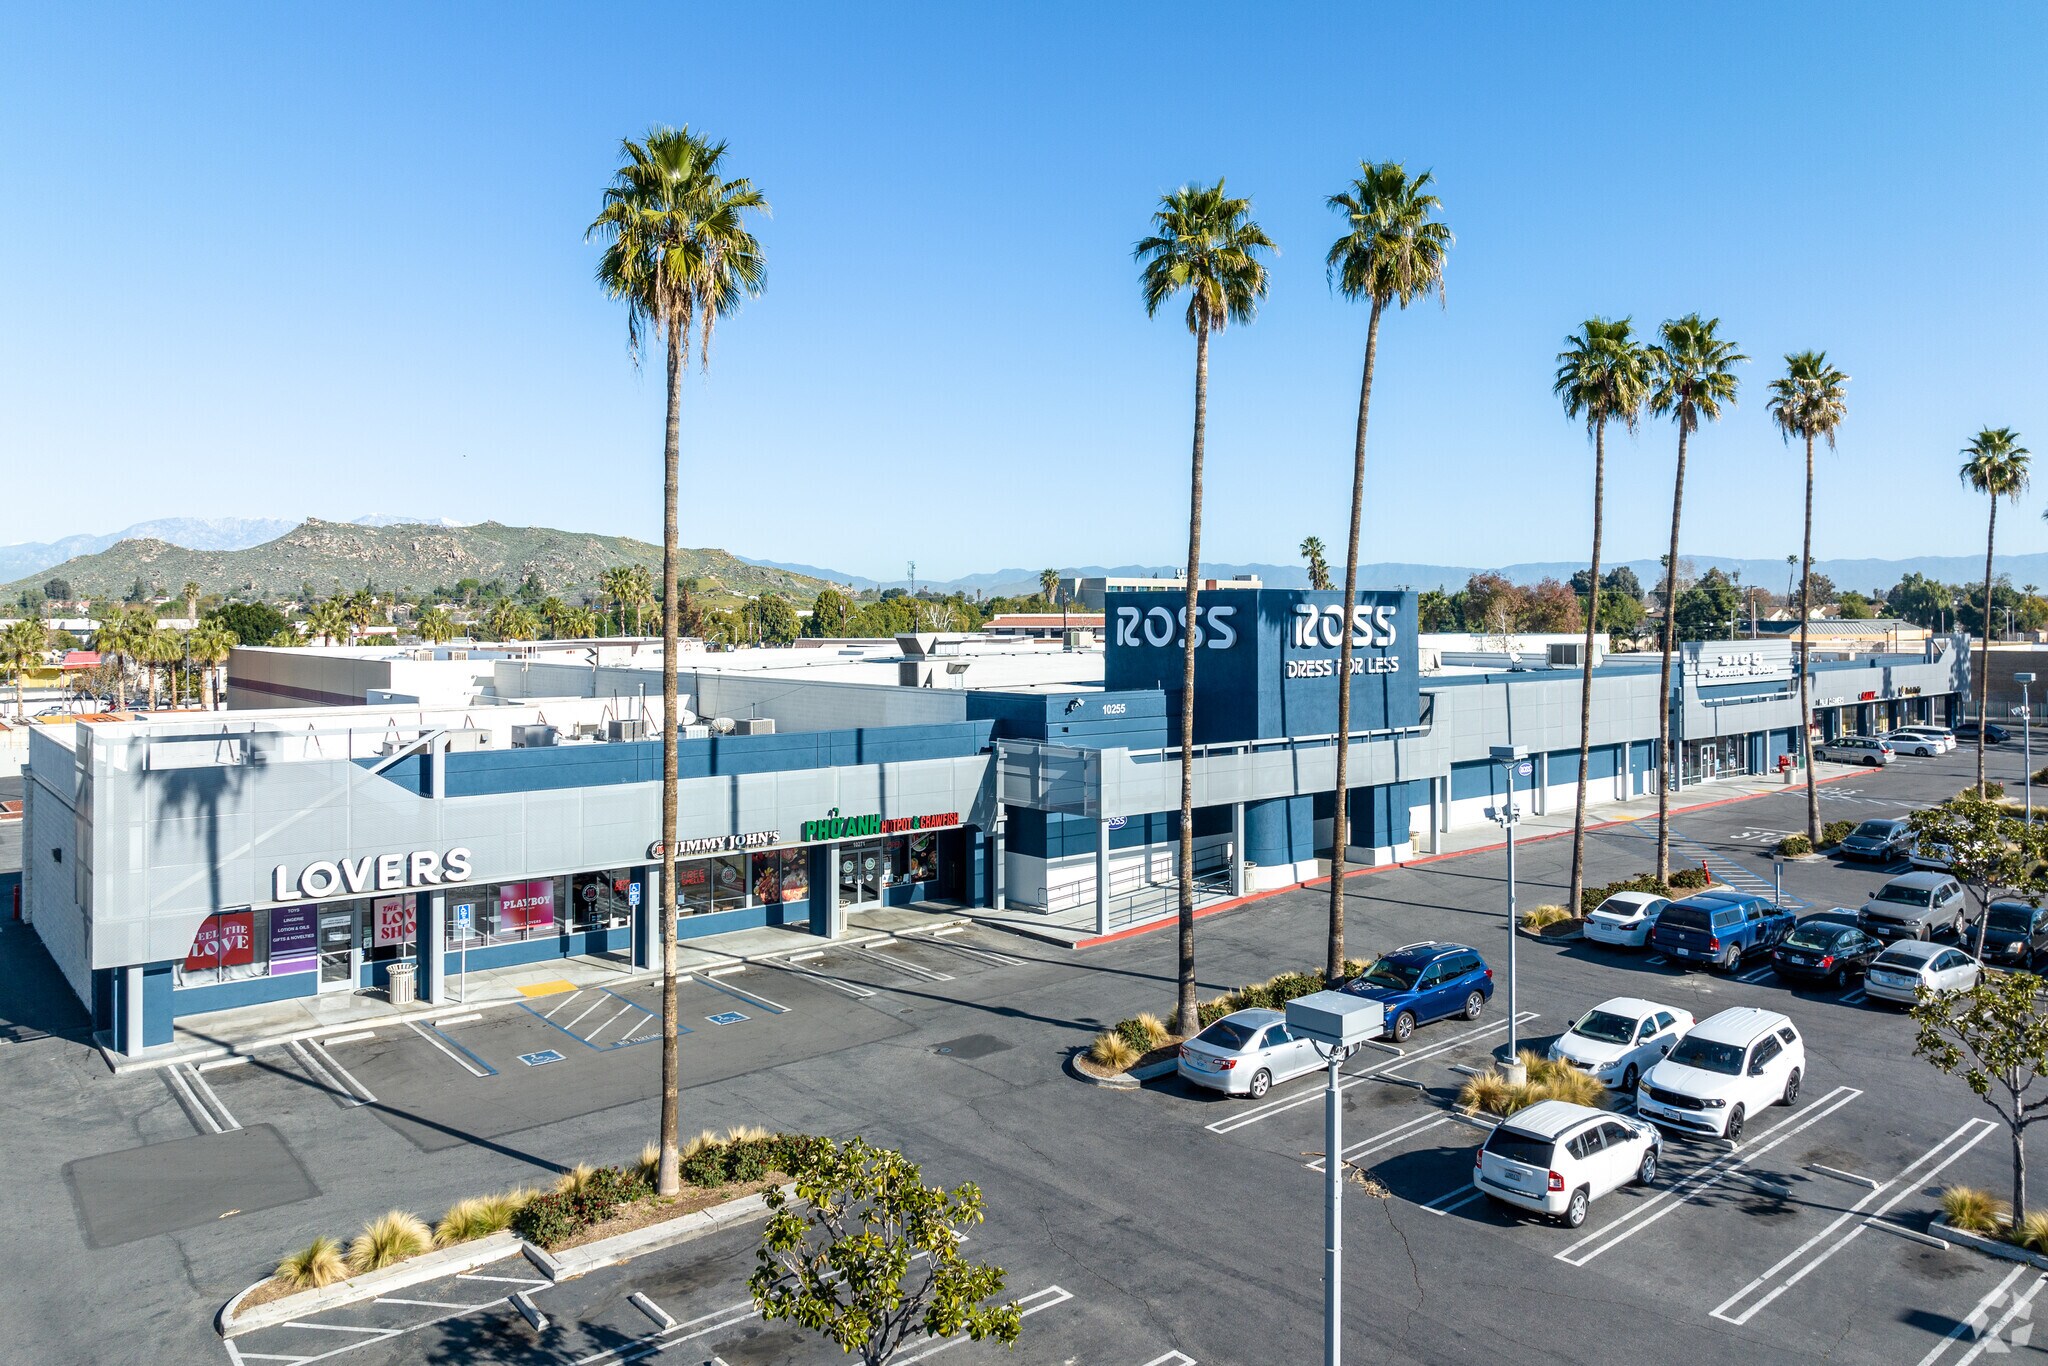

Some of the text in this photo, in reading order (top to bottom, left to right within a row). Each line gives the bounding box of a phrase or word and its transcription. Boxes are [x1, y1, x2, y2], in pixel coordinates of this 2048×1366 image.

[1117, 606, 1236, 649] ROSS
[1296, 604, 1397, 647] ROSS
[1288, 659, 1332, 678] DRESS
[1368, 656, 1399, 674] LESS
[1718, 654, 1748, 667] BIG
[1102, 704, 1126, 714] 10255
[845, 814, 880, 838] ANH
[881, 817, 913, 834] HOTPOT
[912, 816, 920, 829] &
[920, 812, 959, 829] CRAWFISH
[1108, 816, 1125, 826] OSS
[674, 836, 727, 856] JIMMY
[729, 830, 781, 849] JOHN'S
[1729, 831, 1786, 844] STO
[273, 847, 473, 901] LOVERS
[681, 868, 704, 879] FREE
[681, 876, 705, 886] SMELLS
[503, 896, 551, 910] PLAYBOY
[382, 907, 416, 925] LOV
[197, 925, 248, 941] EEL THE
[272, 935, 286, 943] GIFTS
[381, 921, 417, 940] SHO
[191, 935, 249, 957] LOVE
